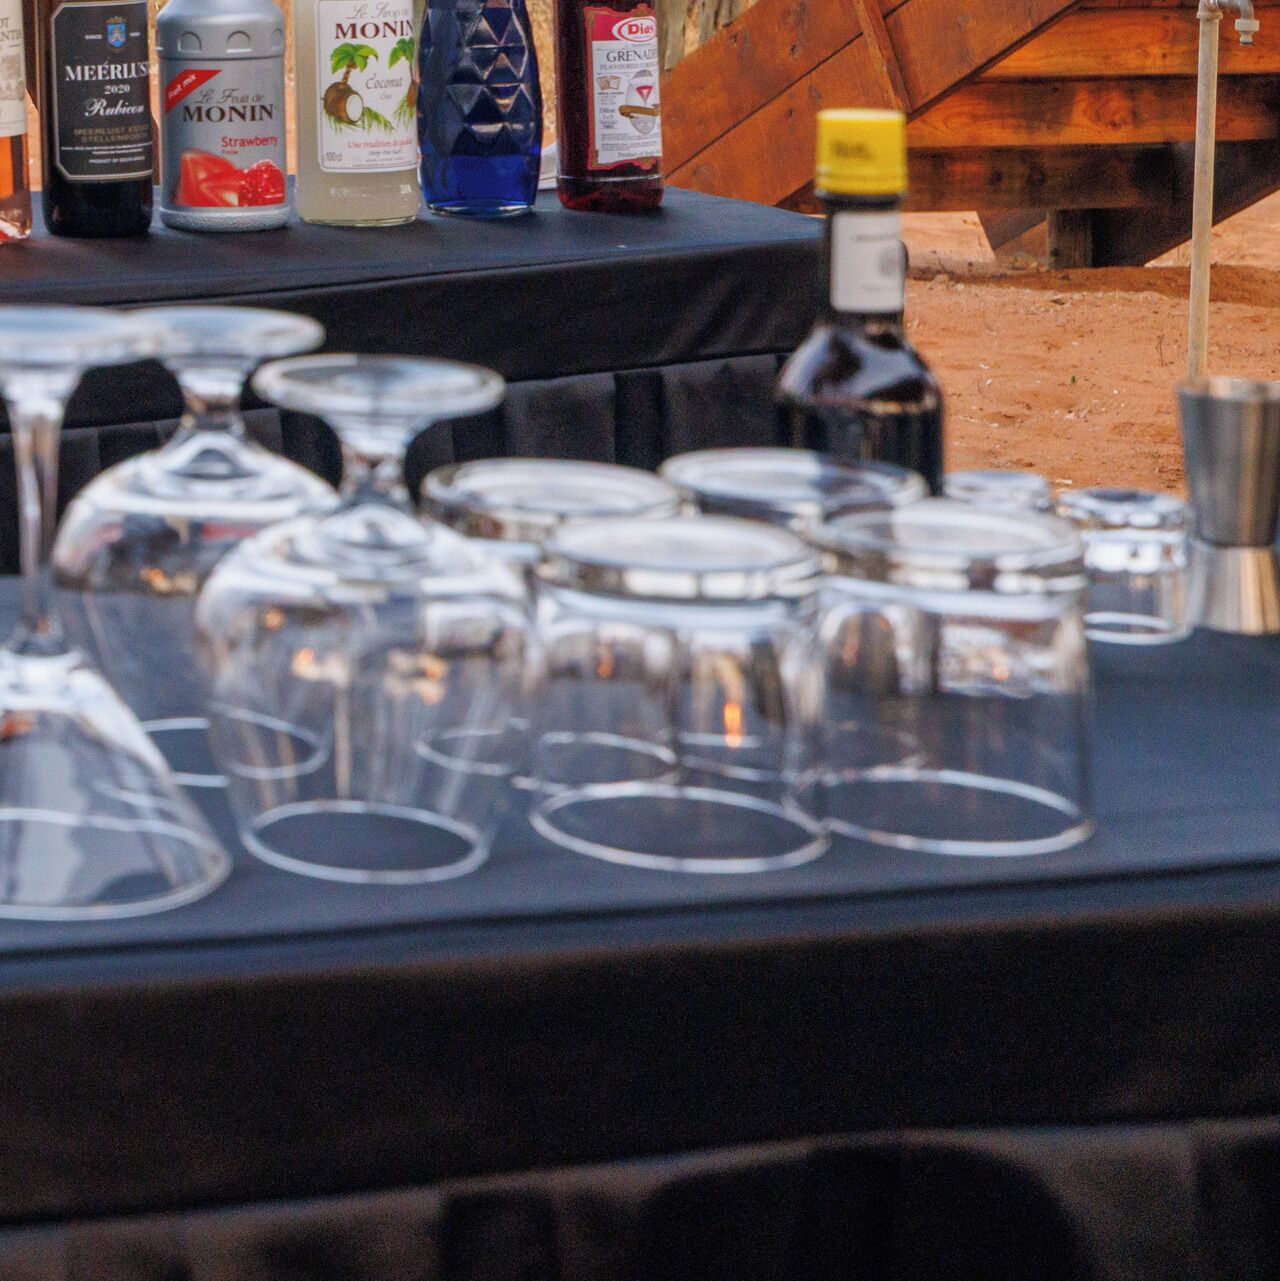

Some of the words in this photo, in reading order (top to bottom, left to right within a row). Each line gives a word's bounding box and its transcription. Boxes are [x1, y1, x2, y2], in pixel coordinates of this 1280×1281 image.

[365, 72, 404, 89] Coconut
[104, 84, 131, 95] 2020
[218, 88, 250, 104] Fruit
[85, 99, 144, 117] Rubicon
[183, 104, 273, 123] MONIN
[222, 136, 278, 149] Strawberry
